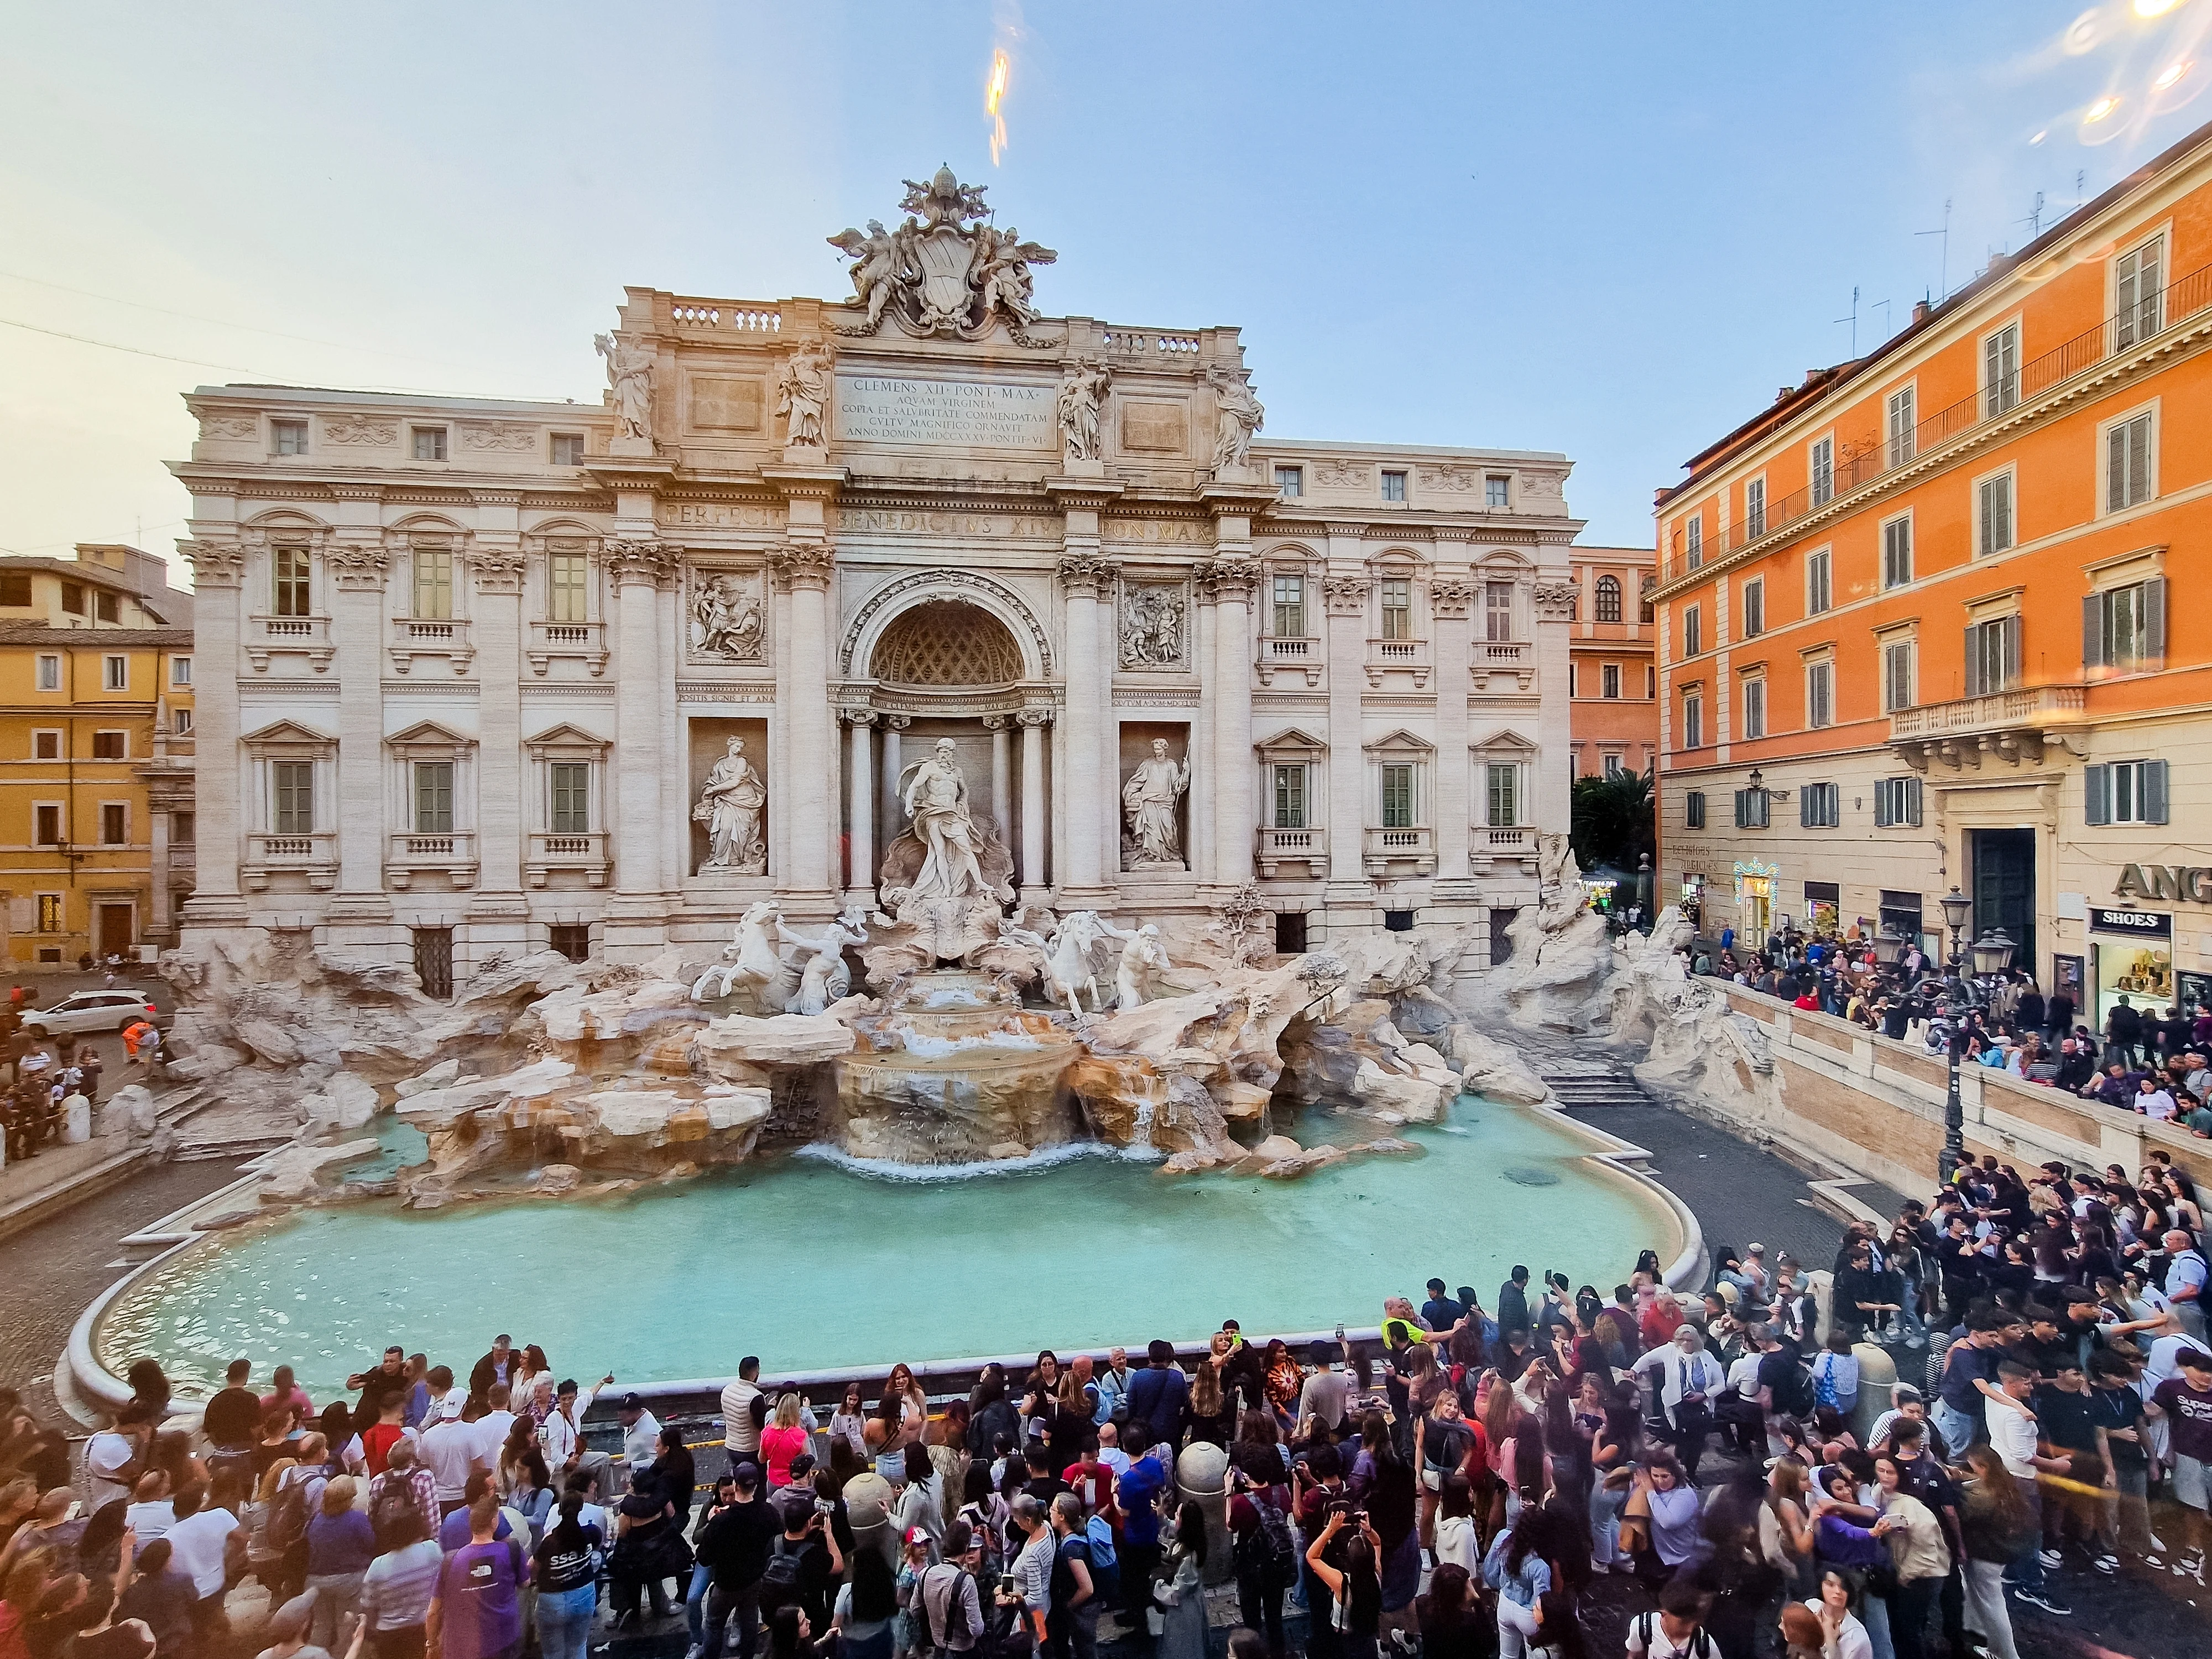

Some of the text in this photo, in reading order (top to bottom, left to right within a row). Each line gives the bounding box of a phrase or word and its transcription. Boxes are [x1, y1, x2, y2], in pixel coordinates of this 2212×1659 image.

[854, 380, 917, 393] CLEMENS
[942, 398, 995, 409] VIRGINEM
[842, 404, 873, 414] COPIA
[966, 411, 1047, 422] COMMENDATAM
[910, 419, 970, 430] MAGNIFICO
[847, 428, 878, 436] ANNO
[882, 429, 921, 439] DOMINI
[665, 504, 785, 525] PERFECIT
[836, 509, 992, 534] BENEDICTVS
[2103, 911, 2158, 927] SHOES
